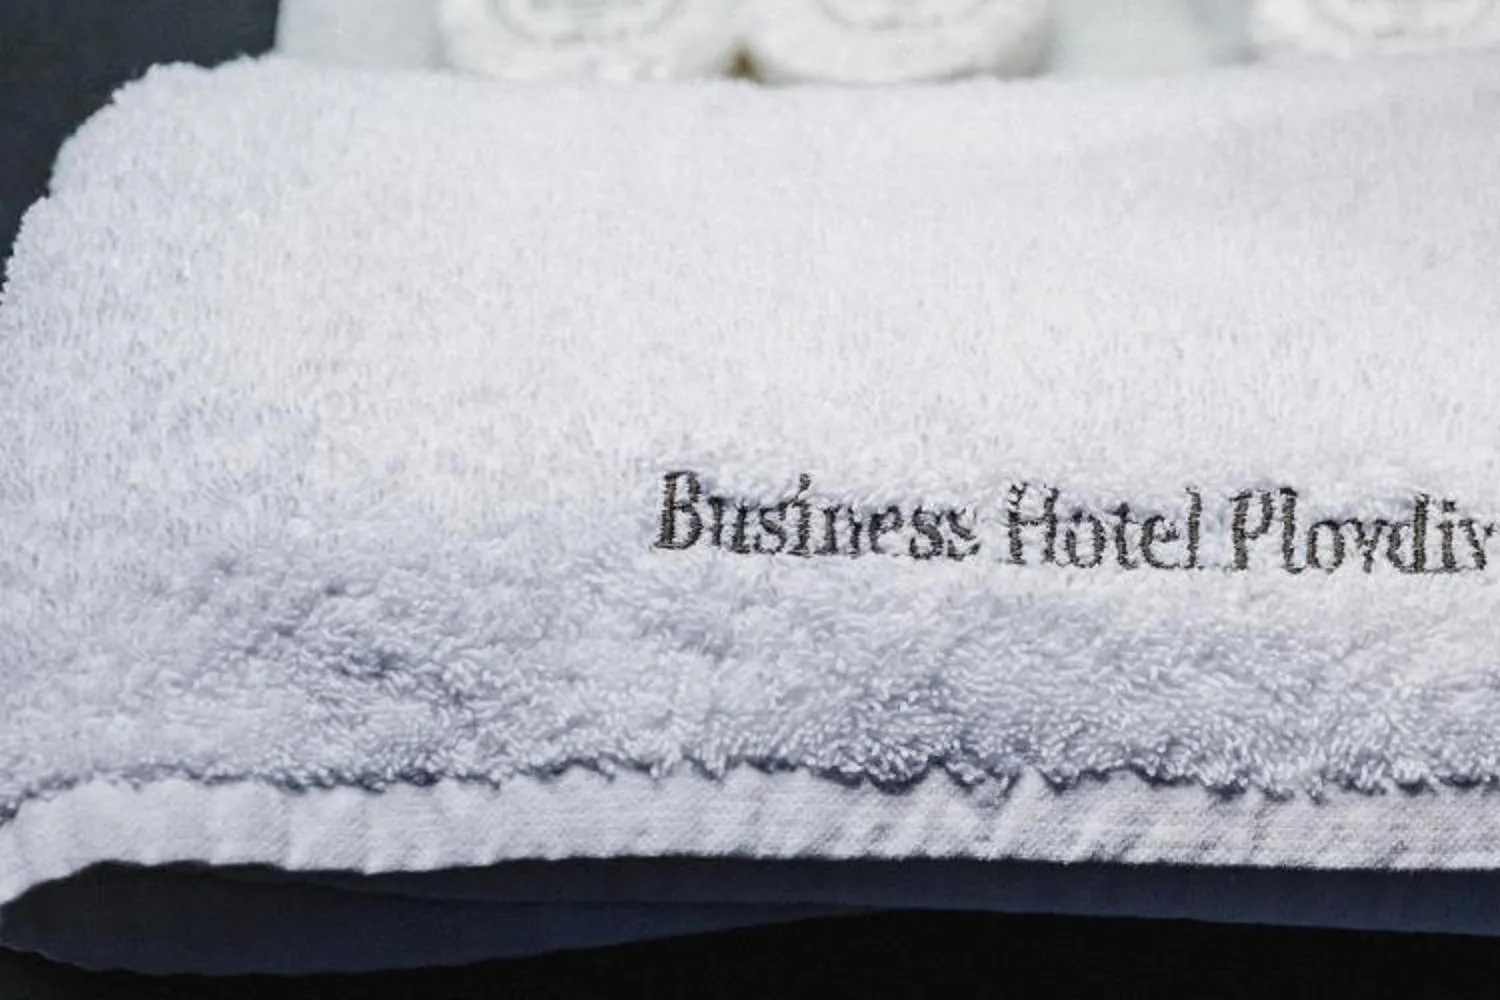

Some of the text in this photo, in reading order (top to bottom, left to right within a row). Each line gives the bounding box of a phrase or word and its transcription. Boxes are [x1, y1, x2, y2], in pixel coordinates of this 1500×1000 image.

[651, 468, 1497, 574] Business Hotel Plovdiv
